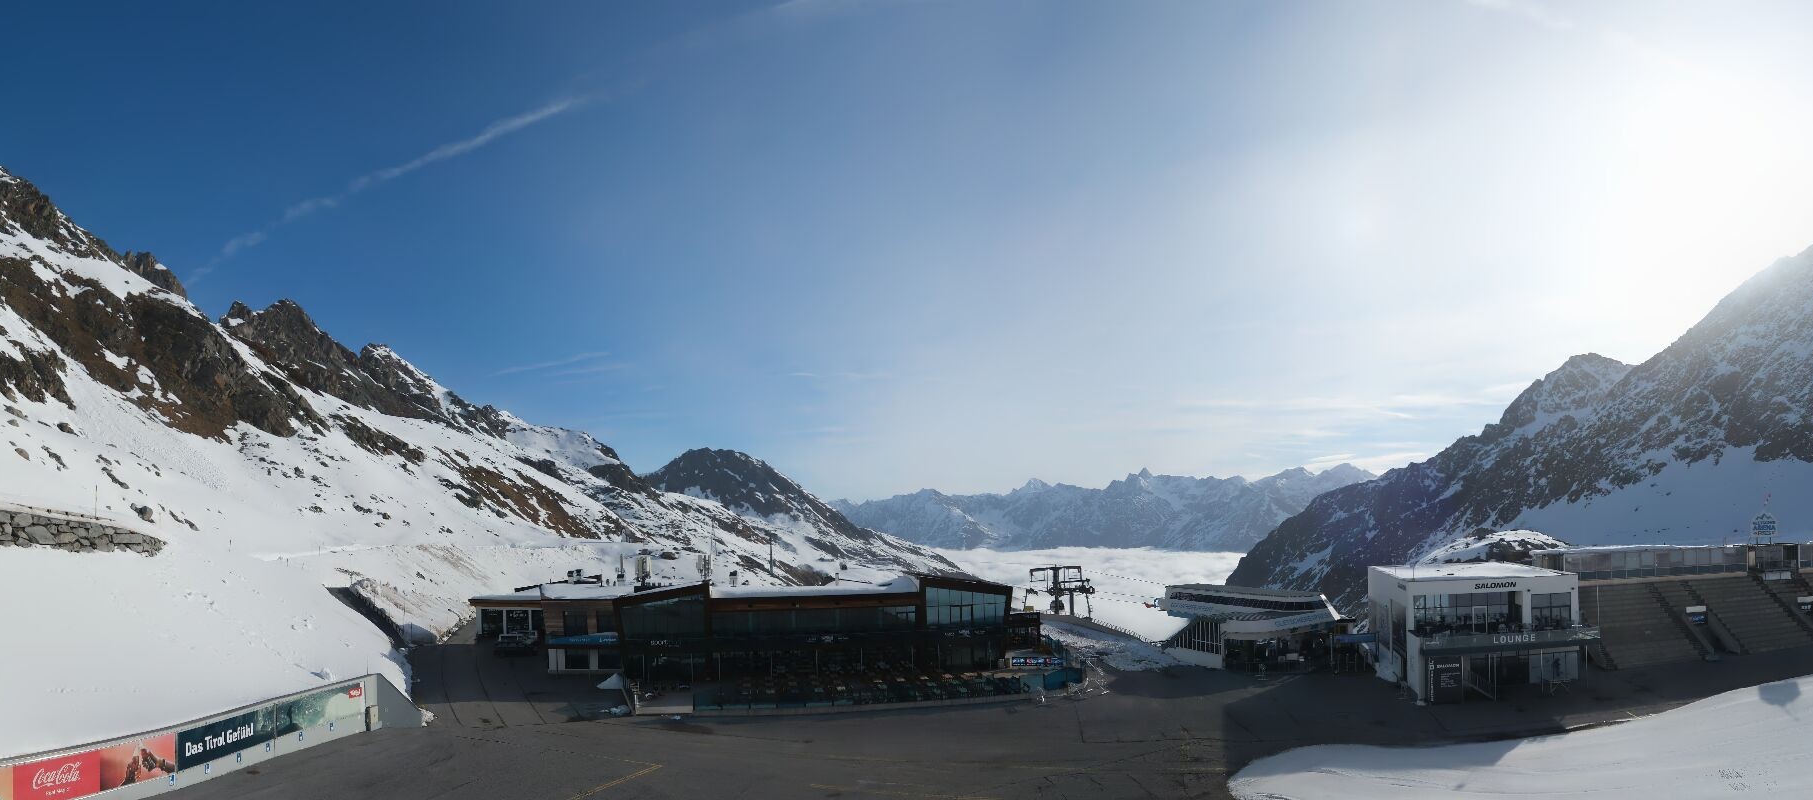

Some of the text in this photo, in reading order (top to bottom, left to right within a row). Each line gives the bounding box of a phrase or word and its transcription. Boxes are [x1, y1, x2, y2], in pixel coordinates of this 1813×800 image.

[1474, 581, 1517, 590] SALOMON
[1493, 633, 1536, 644] LOUNGE
[185, 722, 254, 757] Das Tirol Gefühl
